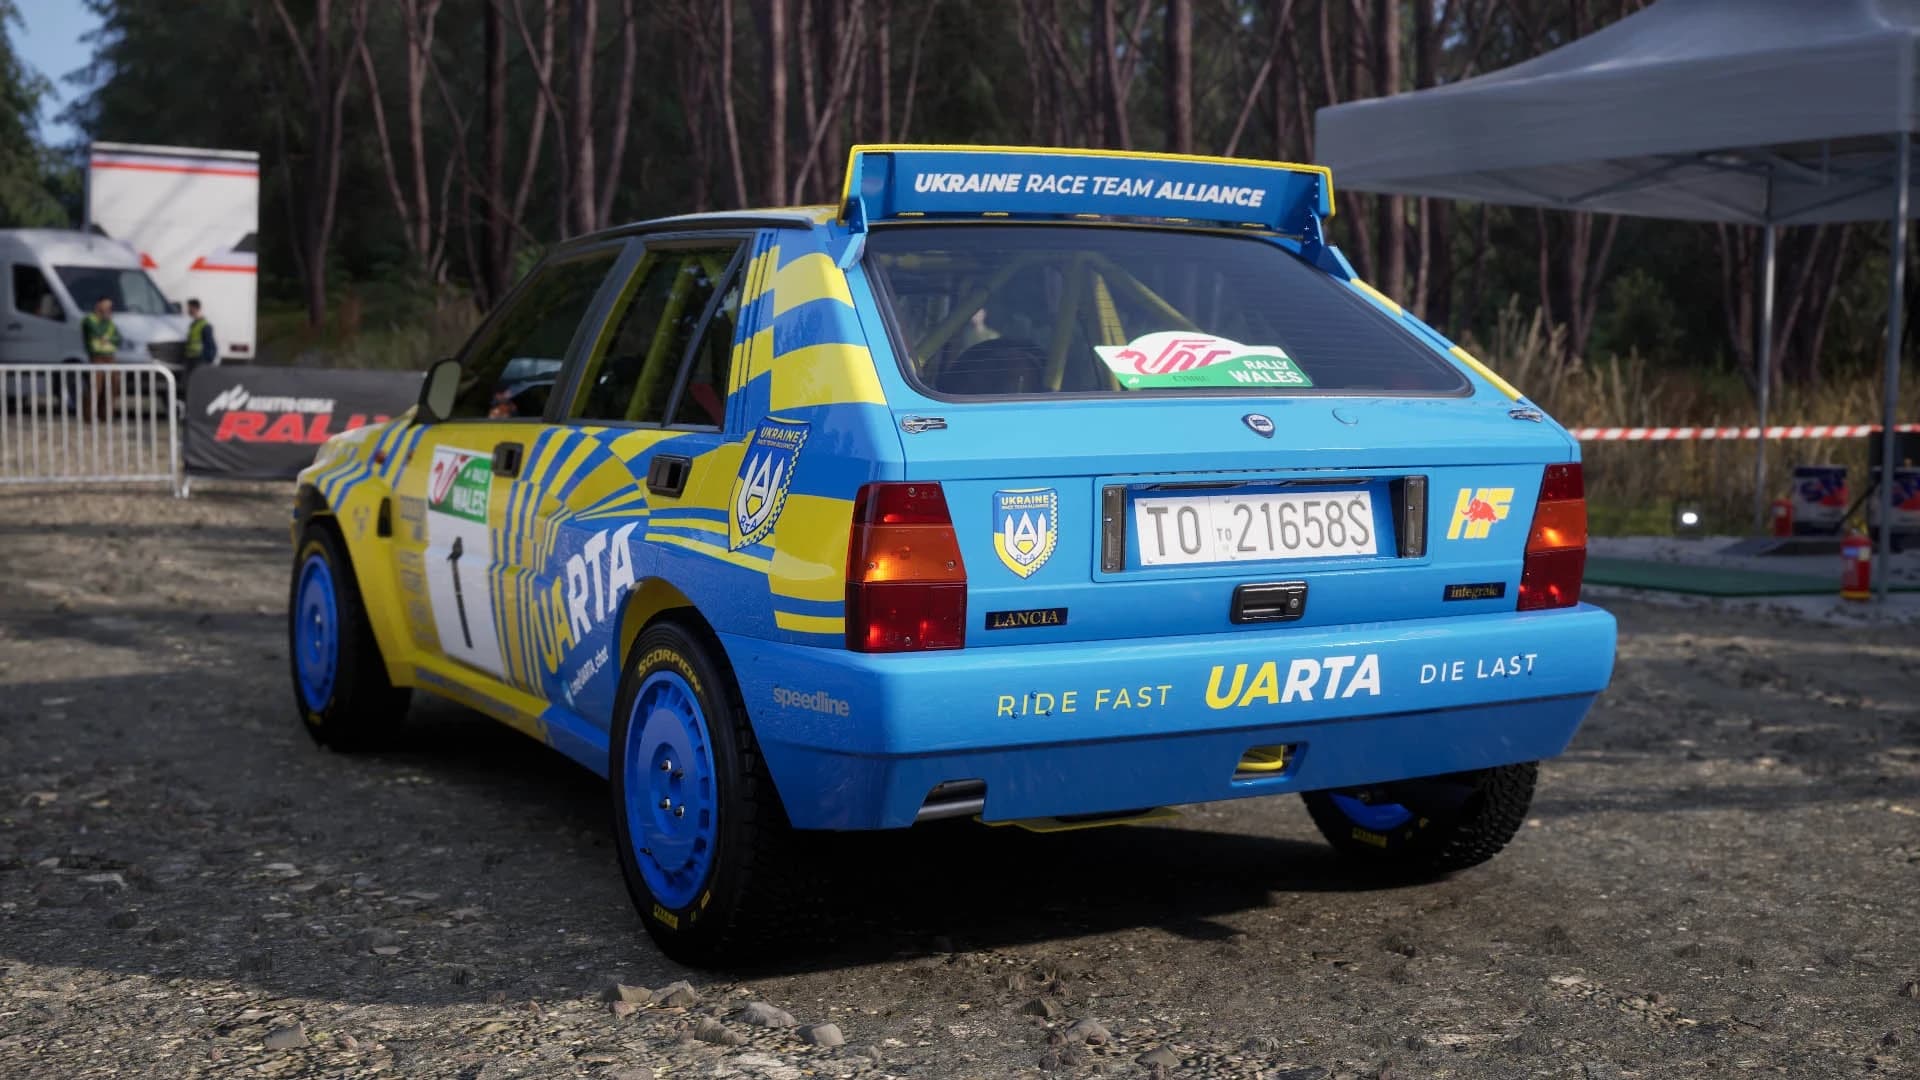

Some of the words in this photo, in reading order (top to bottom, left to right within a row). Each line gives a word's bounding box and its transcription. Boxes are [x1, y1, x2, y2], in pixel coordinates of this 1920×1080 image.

[914, 173, 1022, 192] UKRAINE
[1025, 175, 1088, 194] RACE
[1092, 177, 1154, 198] TEAM
[1155, 182, 1265, 208] ALLIANCE
[1228, 370, 1304, 383] WALES
[1242, 359, 1290, 370] RALLY
[215, 411, 391, 442] RAL
[760, 426, 801, 443] UKRAINE
[1001, 495, 1049, 506] UKRAINE
[1447, 487, 1515, 540] HF
[1147, 505, 1201, 557] TO
[1233, 500, 1370, 552] 21658S
[1216, 527, 1233, 543] TO
[446, 536, 473, 648] 1
[531, 520, 639, 675] UARTA
[994, 610, 1060, 628] LANCIA
[637, 648, 702, 695] SCORPION
[997, 691, 1078, 717] RIDE
[1094, 684, 1173, 711] FAST
[1204, 653, 1381, 710] UARTA
[1419, 661, 1465, 685] DIE
[1476, 653, 1538, 679] LAST
[773, 687, 849, 717] speedline
